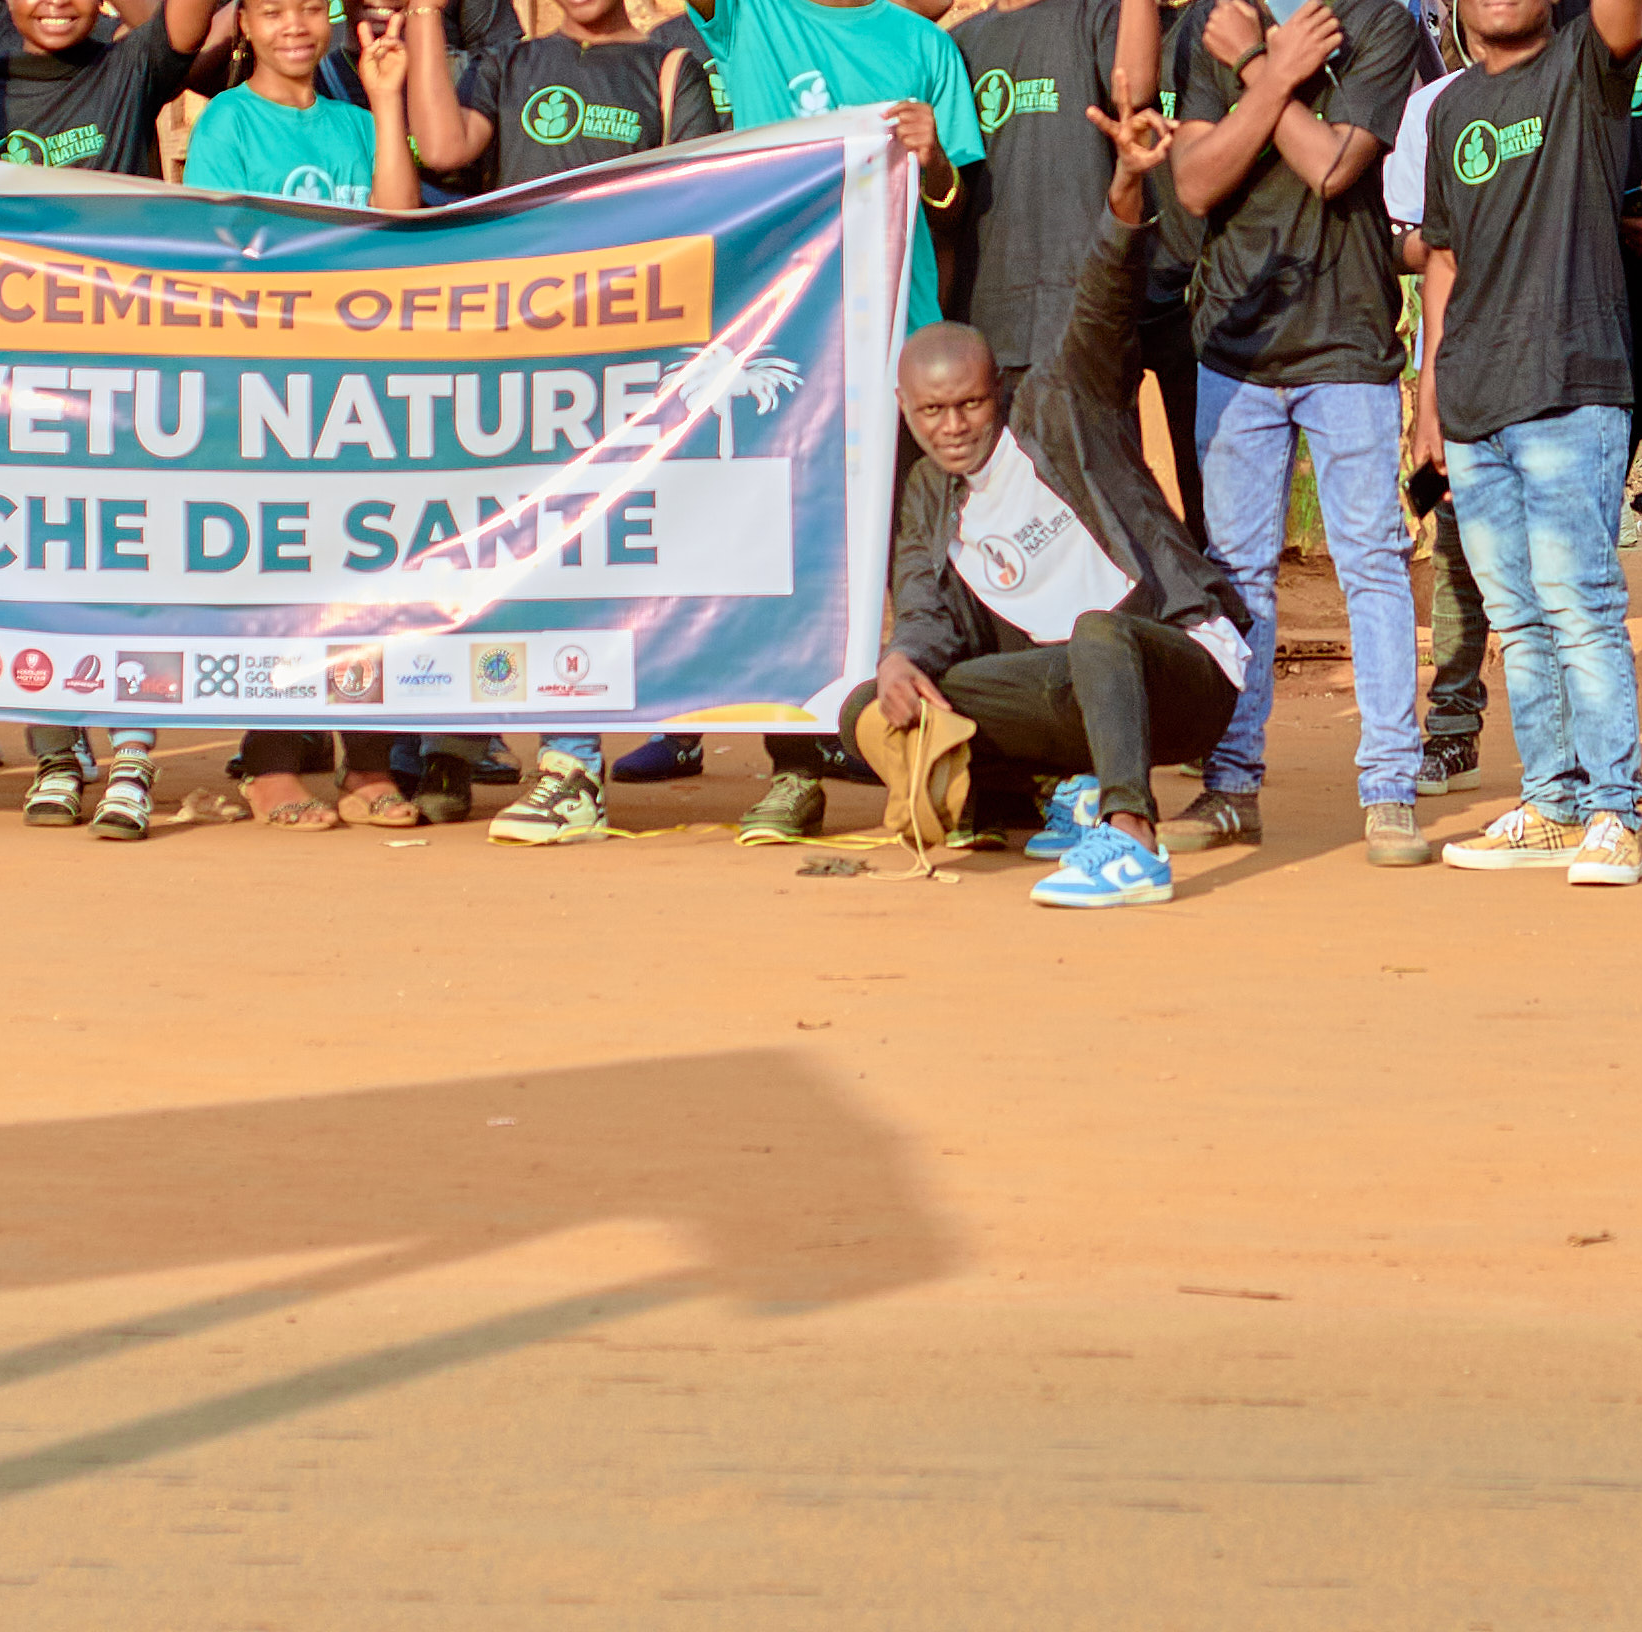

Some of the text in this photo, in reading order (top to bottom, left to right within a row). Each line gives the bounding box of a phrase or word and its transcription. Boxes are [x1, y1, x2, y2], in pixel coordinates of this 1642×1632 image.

[586, 103, 640, 123] KWETU
[45, 123, 98, 151] KWETU
[48, 133, 106, 165] NATURE
[333, 263, 686, 333] OFFICIEL
[239, 360, 663, 461] NATURE
[183, 498, 313, 575] DE
[342, 490, 660, 572] SANTE
[244, 686, 316, 700] BUSINESS
